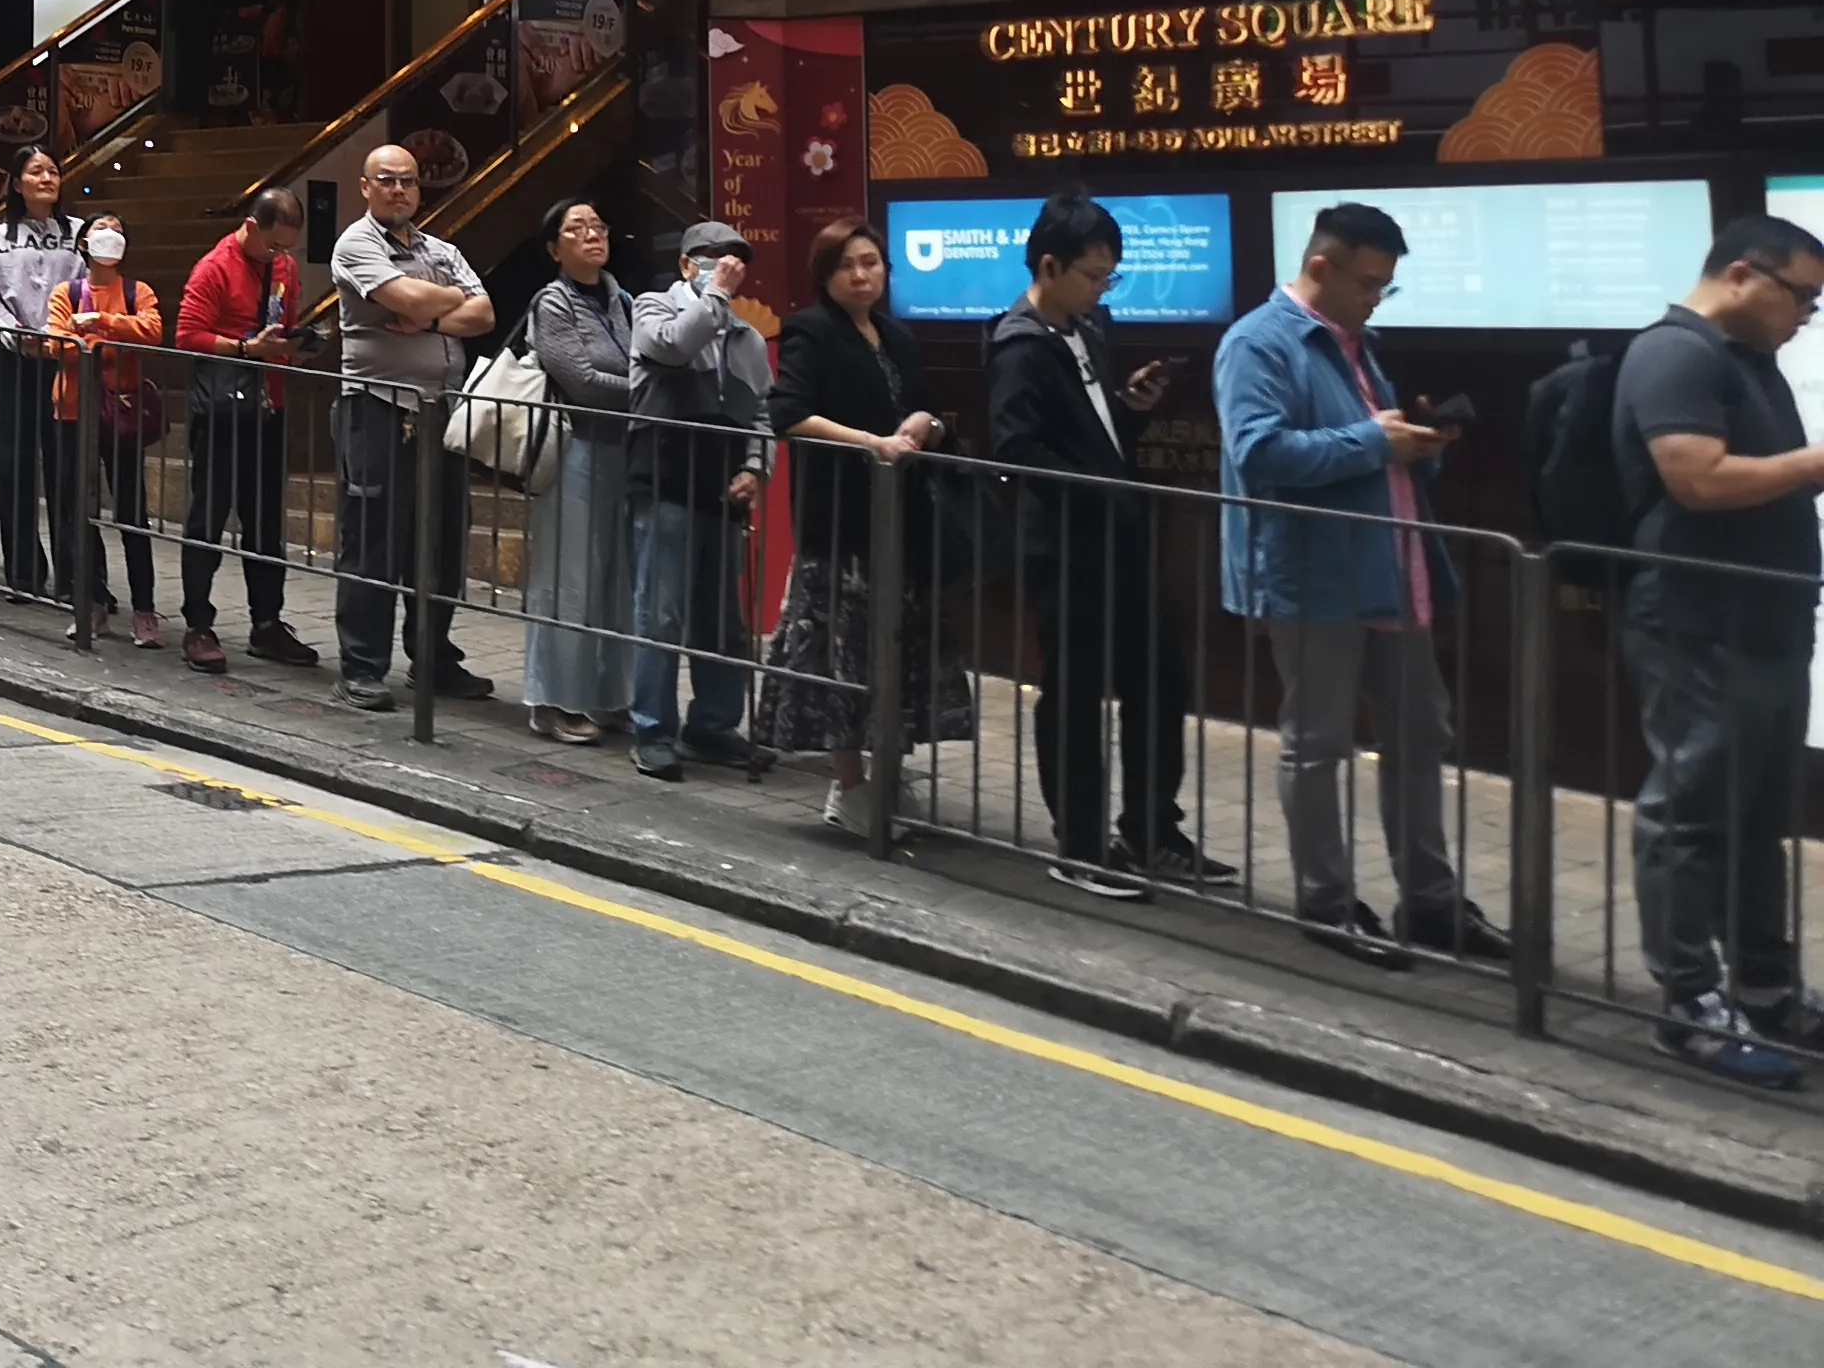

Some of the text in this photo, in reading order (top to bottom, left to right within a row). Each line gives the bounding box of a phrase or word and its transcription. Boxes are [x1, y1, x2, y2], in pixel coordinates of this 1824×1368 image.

[592, 13, 616, 31] 19/F
[983, 6, 1206, 62] CENTURY
[130, 58, 153, 72] 19/F
[1057, 53, 1347, 115] 世紀廣場
[723, 148, 764, 171] Year
[724, 174, 742, 195] of
[724, 200, 753, 217] the
[943, 229, 1031, 245] SMITH & JA
[943, 246, 1000, 260] DENTISTS
